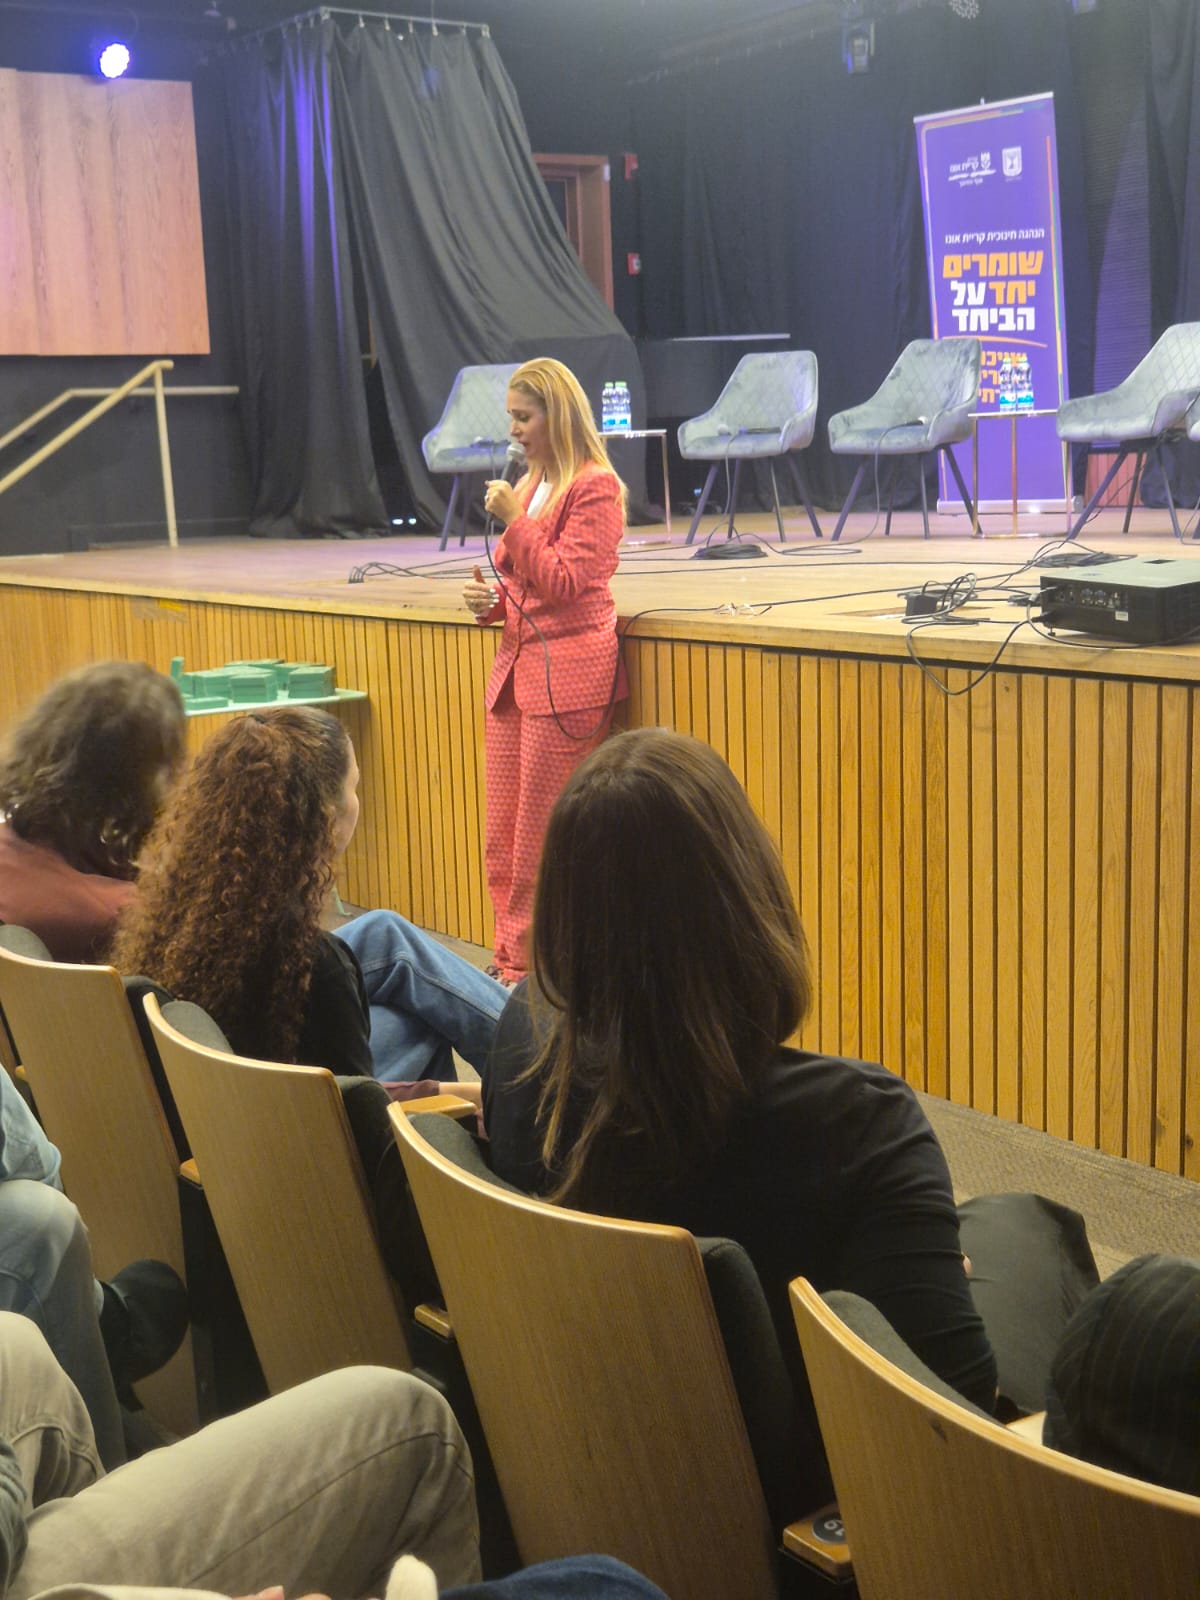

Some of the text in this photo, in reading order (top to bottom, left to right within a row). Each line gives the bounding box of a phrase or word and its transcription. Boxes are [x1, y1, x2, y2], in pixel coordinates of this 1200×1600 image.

[945, 234, 961, 244] אונו
[962, 232, 986, 245] קריית
[986, 230, 1017, 242] חינוכית
[943, 250, 1043, 278] שומרים
[950, 280, 1036, 306] יחד על
[951, 307, 1035, 332] הביחד
